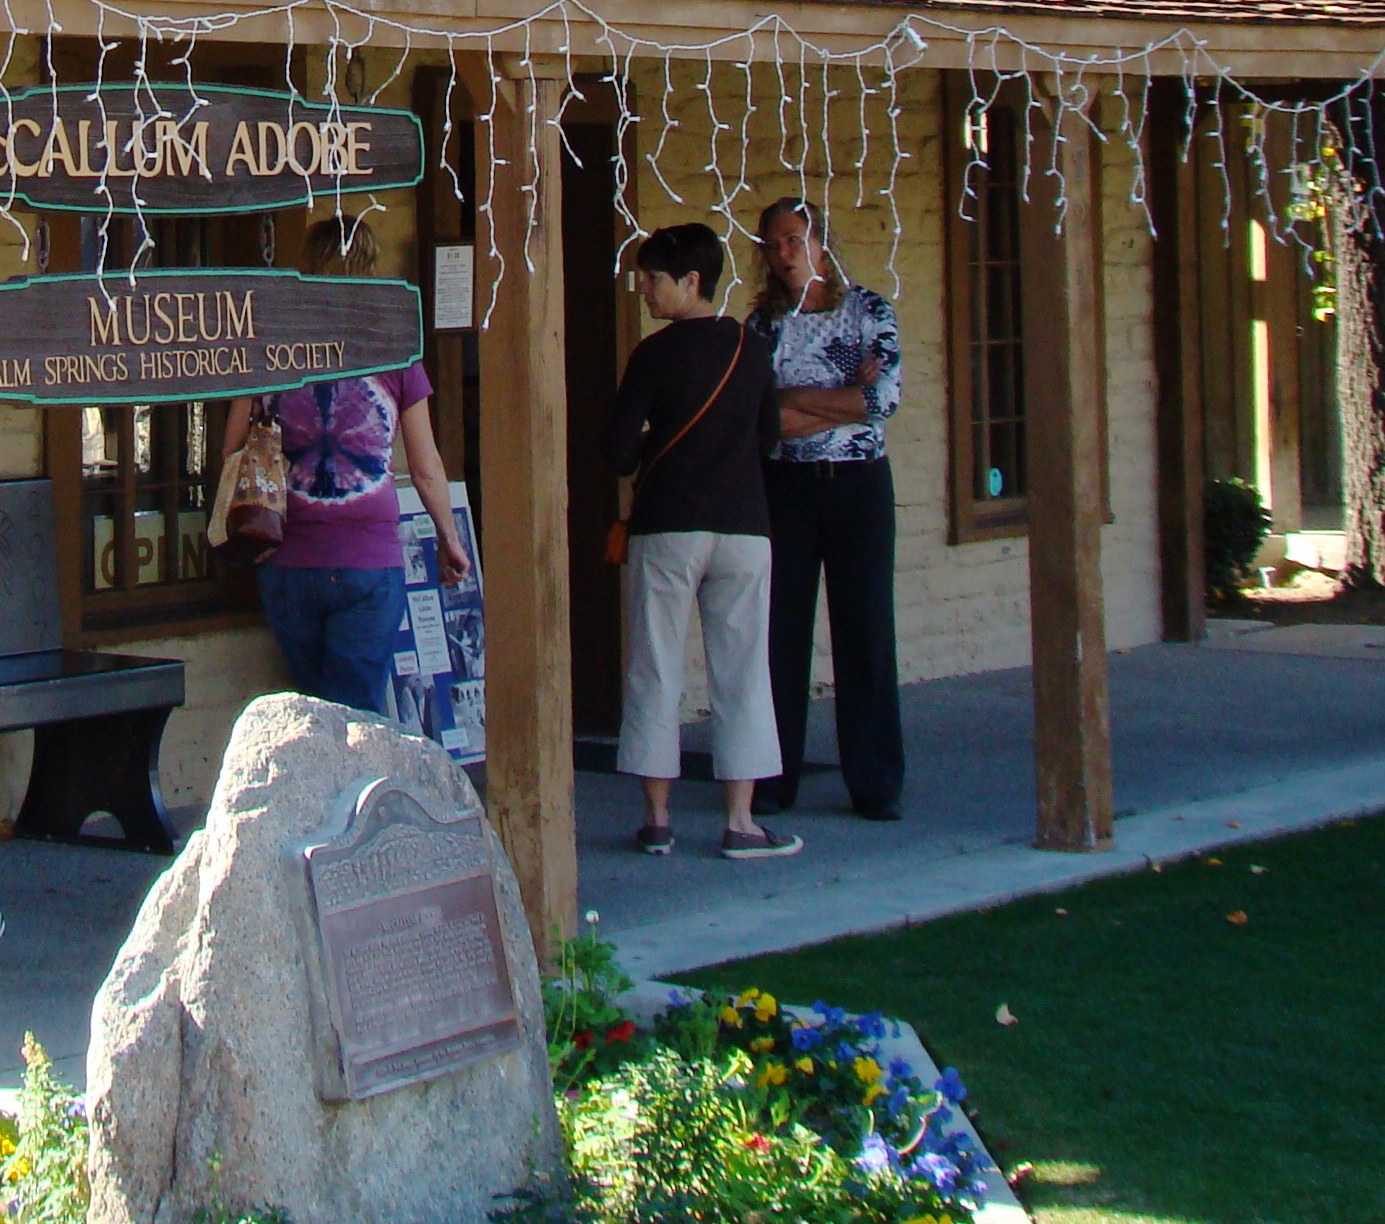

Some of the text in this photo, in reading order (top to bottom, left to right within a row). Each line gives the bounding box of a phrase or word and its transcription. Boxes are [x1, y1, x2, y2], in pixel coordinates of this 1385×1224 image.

[225, 120, 374, 177] ADOBE
[88, 289, 256, 347] MUSEUM
[43, 352, 129, 386] SPRINGS
[139, 346, 253, 381] HISTORICAL
[265, 340, 346, 373] SOCIETY
